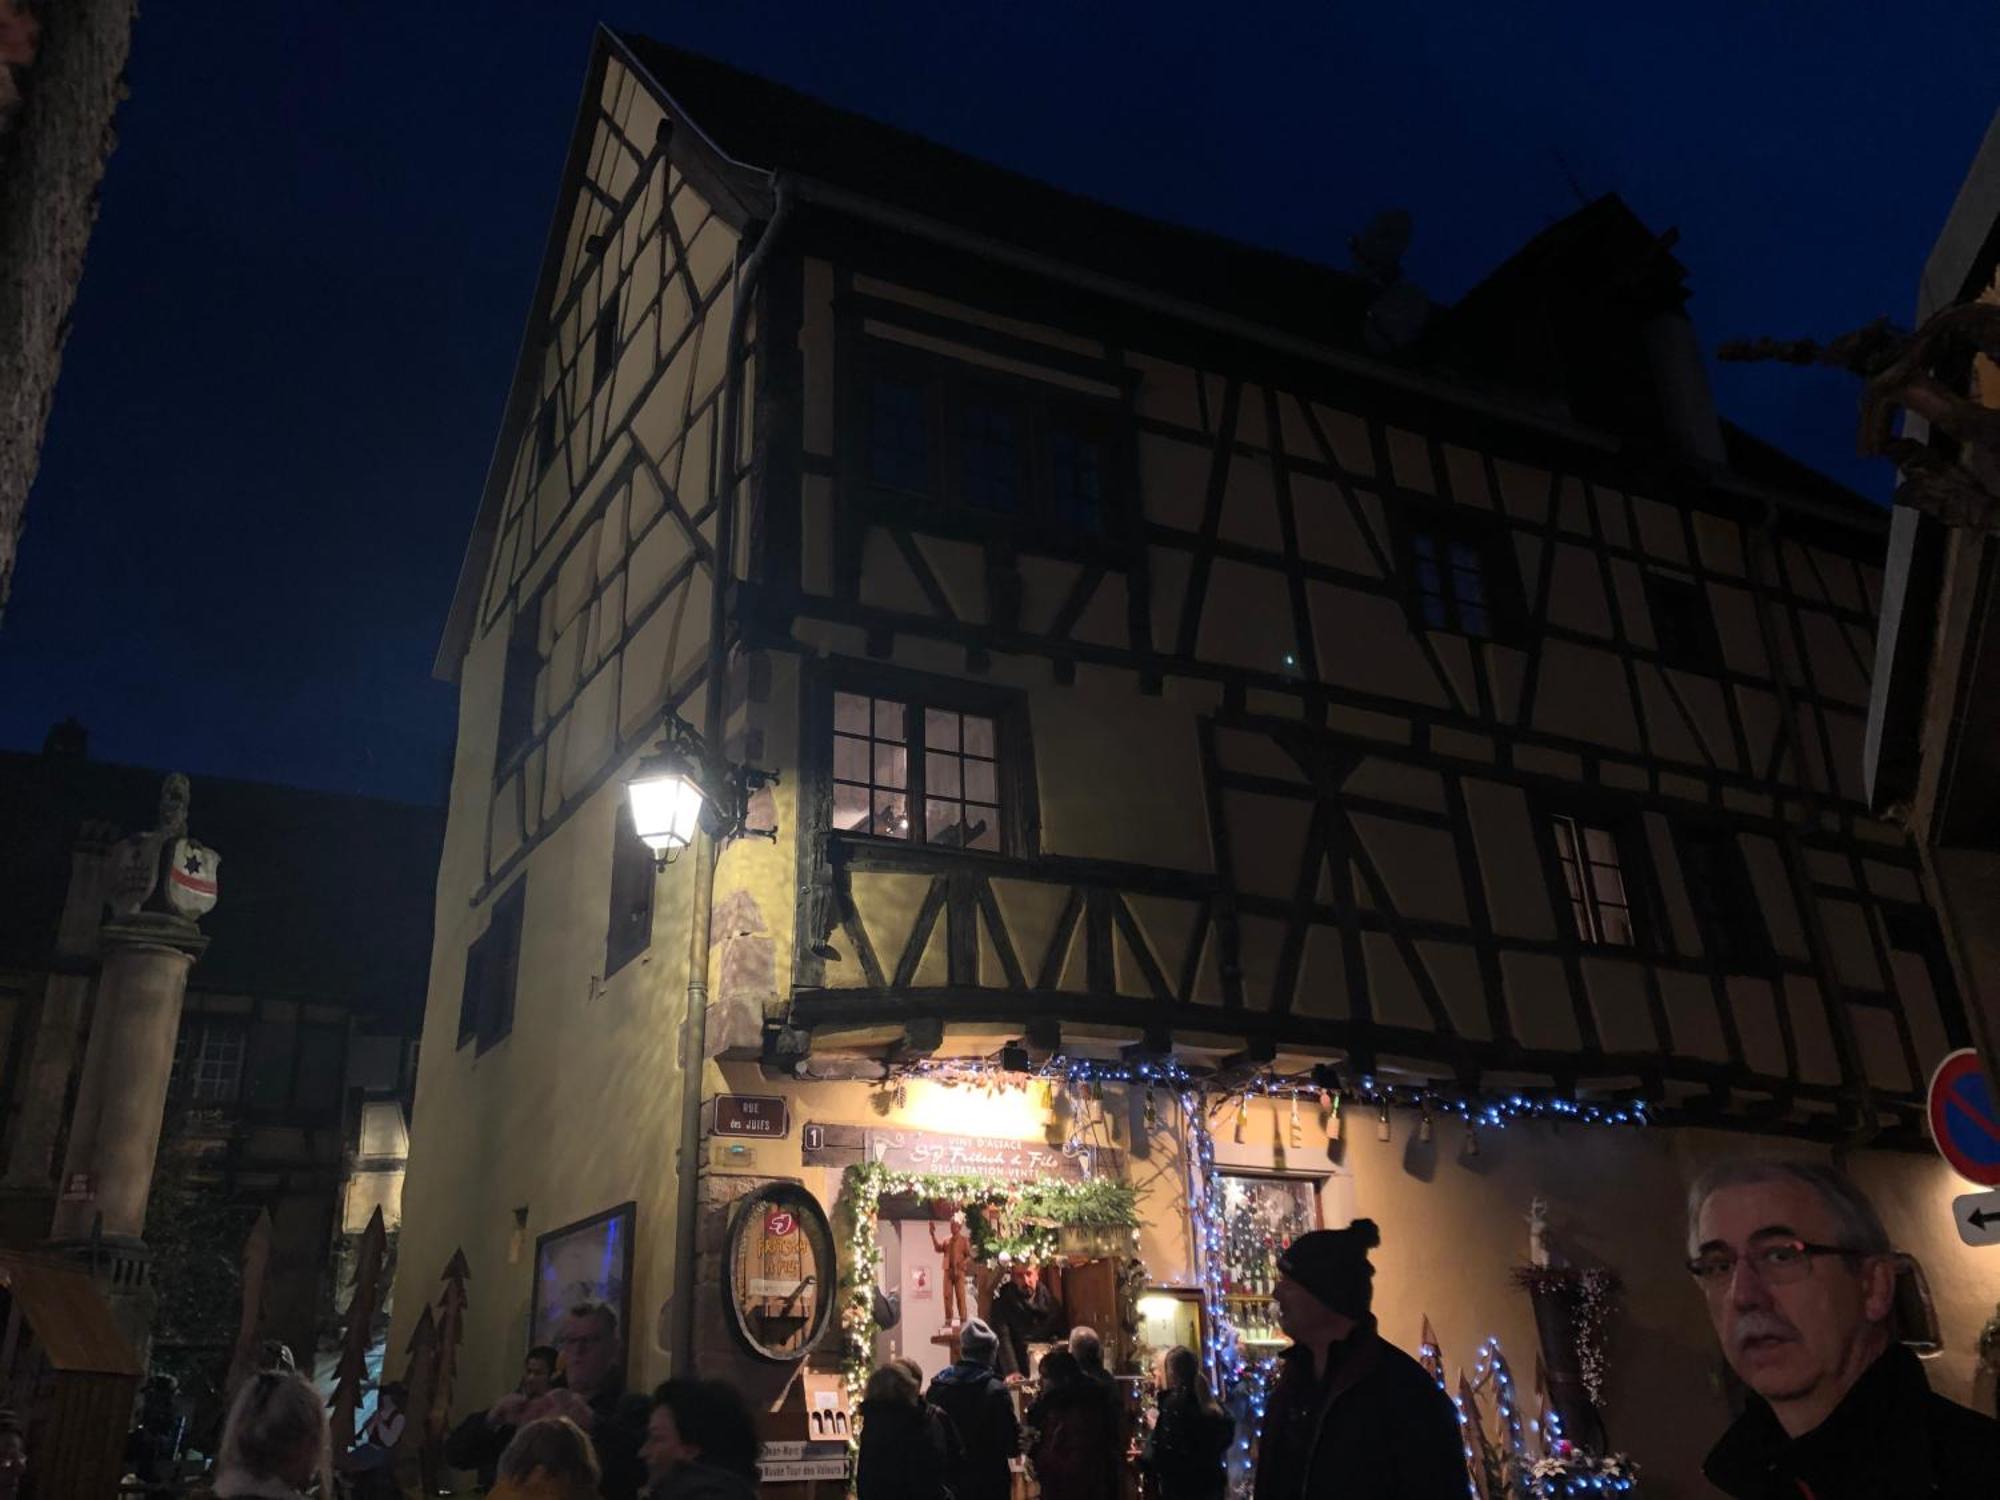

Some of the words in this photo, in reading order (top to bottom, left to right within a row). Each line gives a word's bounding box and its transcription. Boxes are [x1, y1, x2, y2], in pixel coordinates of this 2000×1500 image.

[743, 1103, 759, 1113] RUE
[730, 1119, 742, 1130] des
[746, 1120, 770, 1130] JUIFS
[810, 1129, 817, 1147] 1
[950, 1138, 974, 1148] VINS
[977, 1139, 1023, 1150] D'ALSACE
